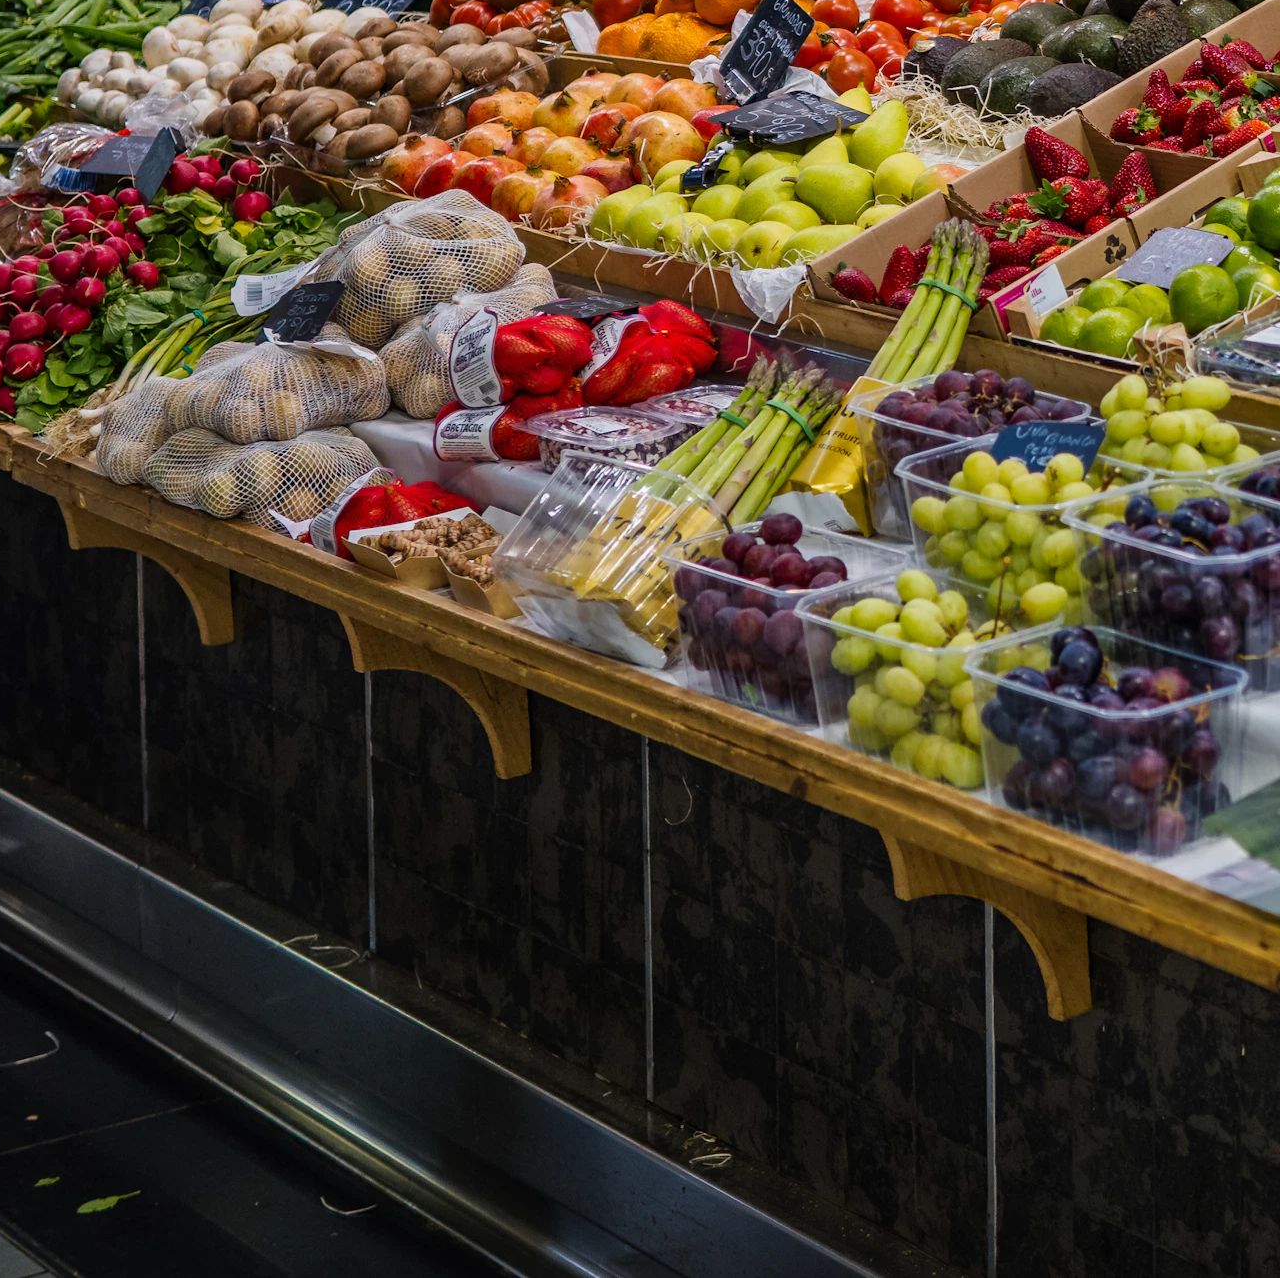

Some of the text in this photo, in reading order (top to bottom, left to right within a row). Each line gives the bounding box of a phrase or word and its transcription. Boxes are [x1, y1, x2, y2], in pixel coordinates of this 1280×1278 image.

[456, 344, 488, 367] BRETAGNE
[445, 423, 484, 433] BRETAGNE
[817, 442, 852, 458] SELECCIÓN
